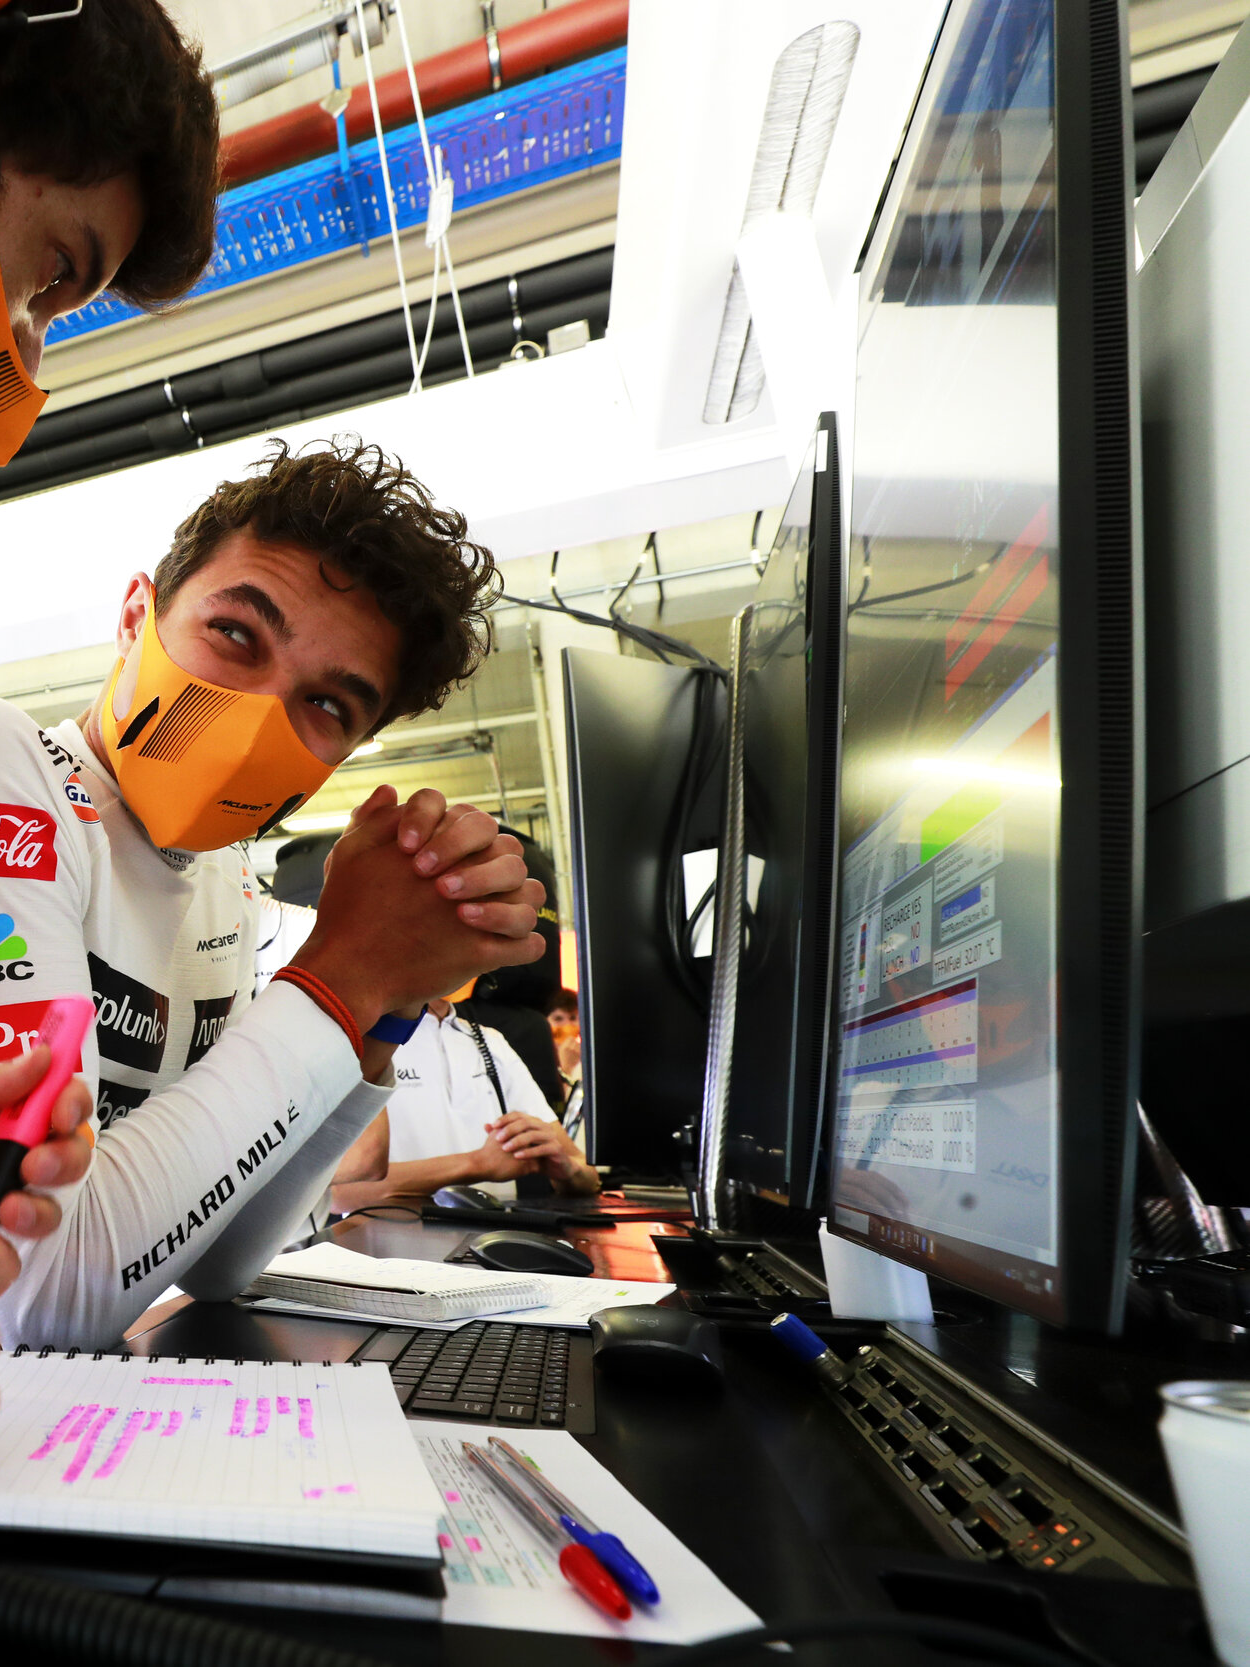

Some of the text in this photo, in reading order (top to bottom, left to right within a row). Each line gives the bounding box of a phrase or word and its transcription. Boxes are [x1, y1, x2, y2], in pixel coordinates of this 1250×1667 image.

[216, 799, 263, 812] McLaren
[196, 932, 239, 952] Mcaren
[121, 1174, 236, 1291] RICHARD
